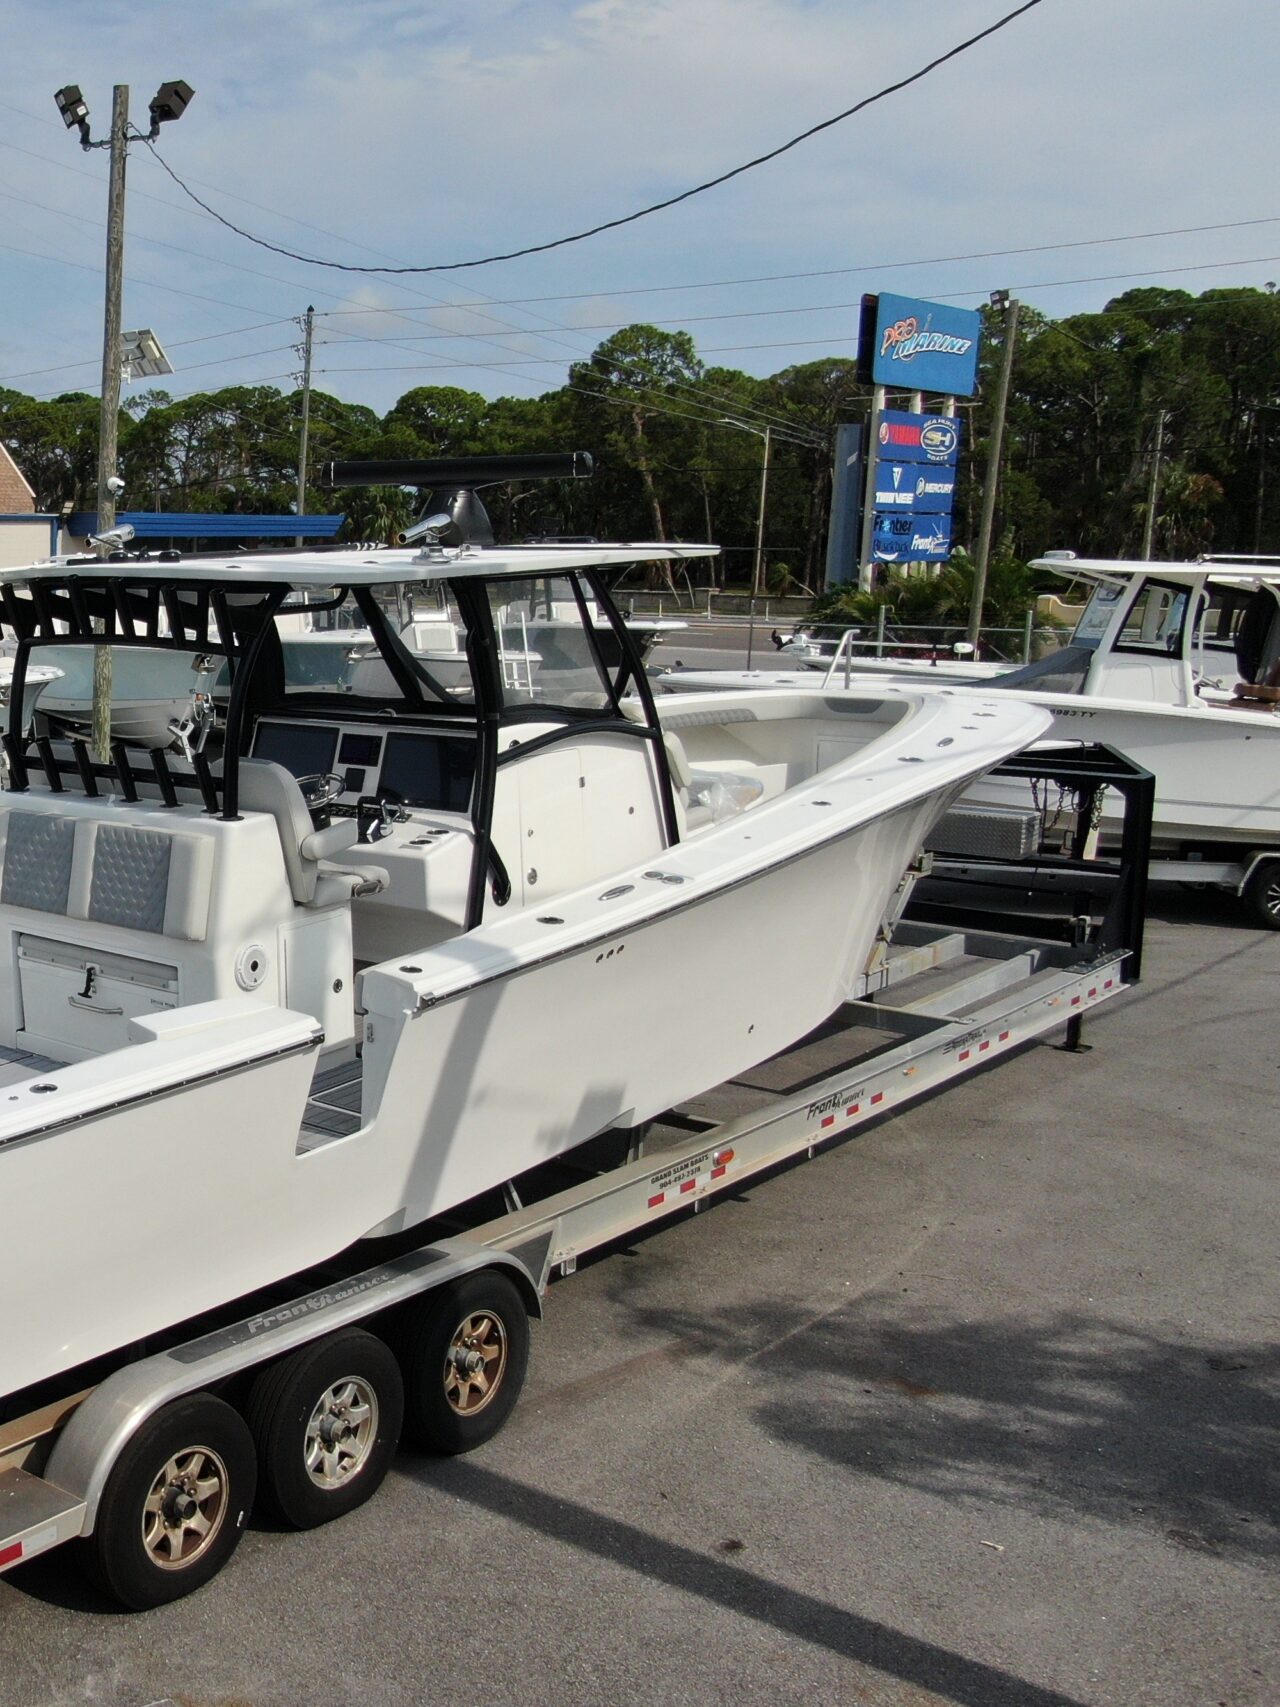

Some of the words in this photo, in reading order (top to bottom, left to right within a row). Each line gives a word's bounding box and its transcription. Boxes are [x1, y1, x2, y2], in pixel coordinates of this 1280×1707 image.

[1080, 710, 1097, 718] TY
[650, 1171, 672, 1185] GRAND
[672, 1162, 690, 1176] SLAM
[690, 1153, 709, 1168] BOATS
